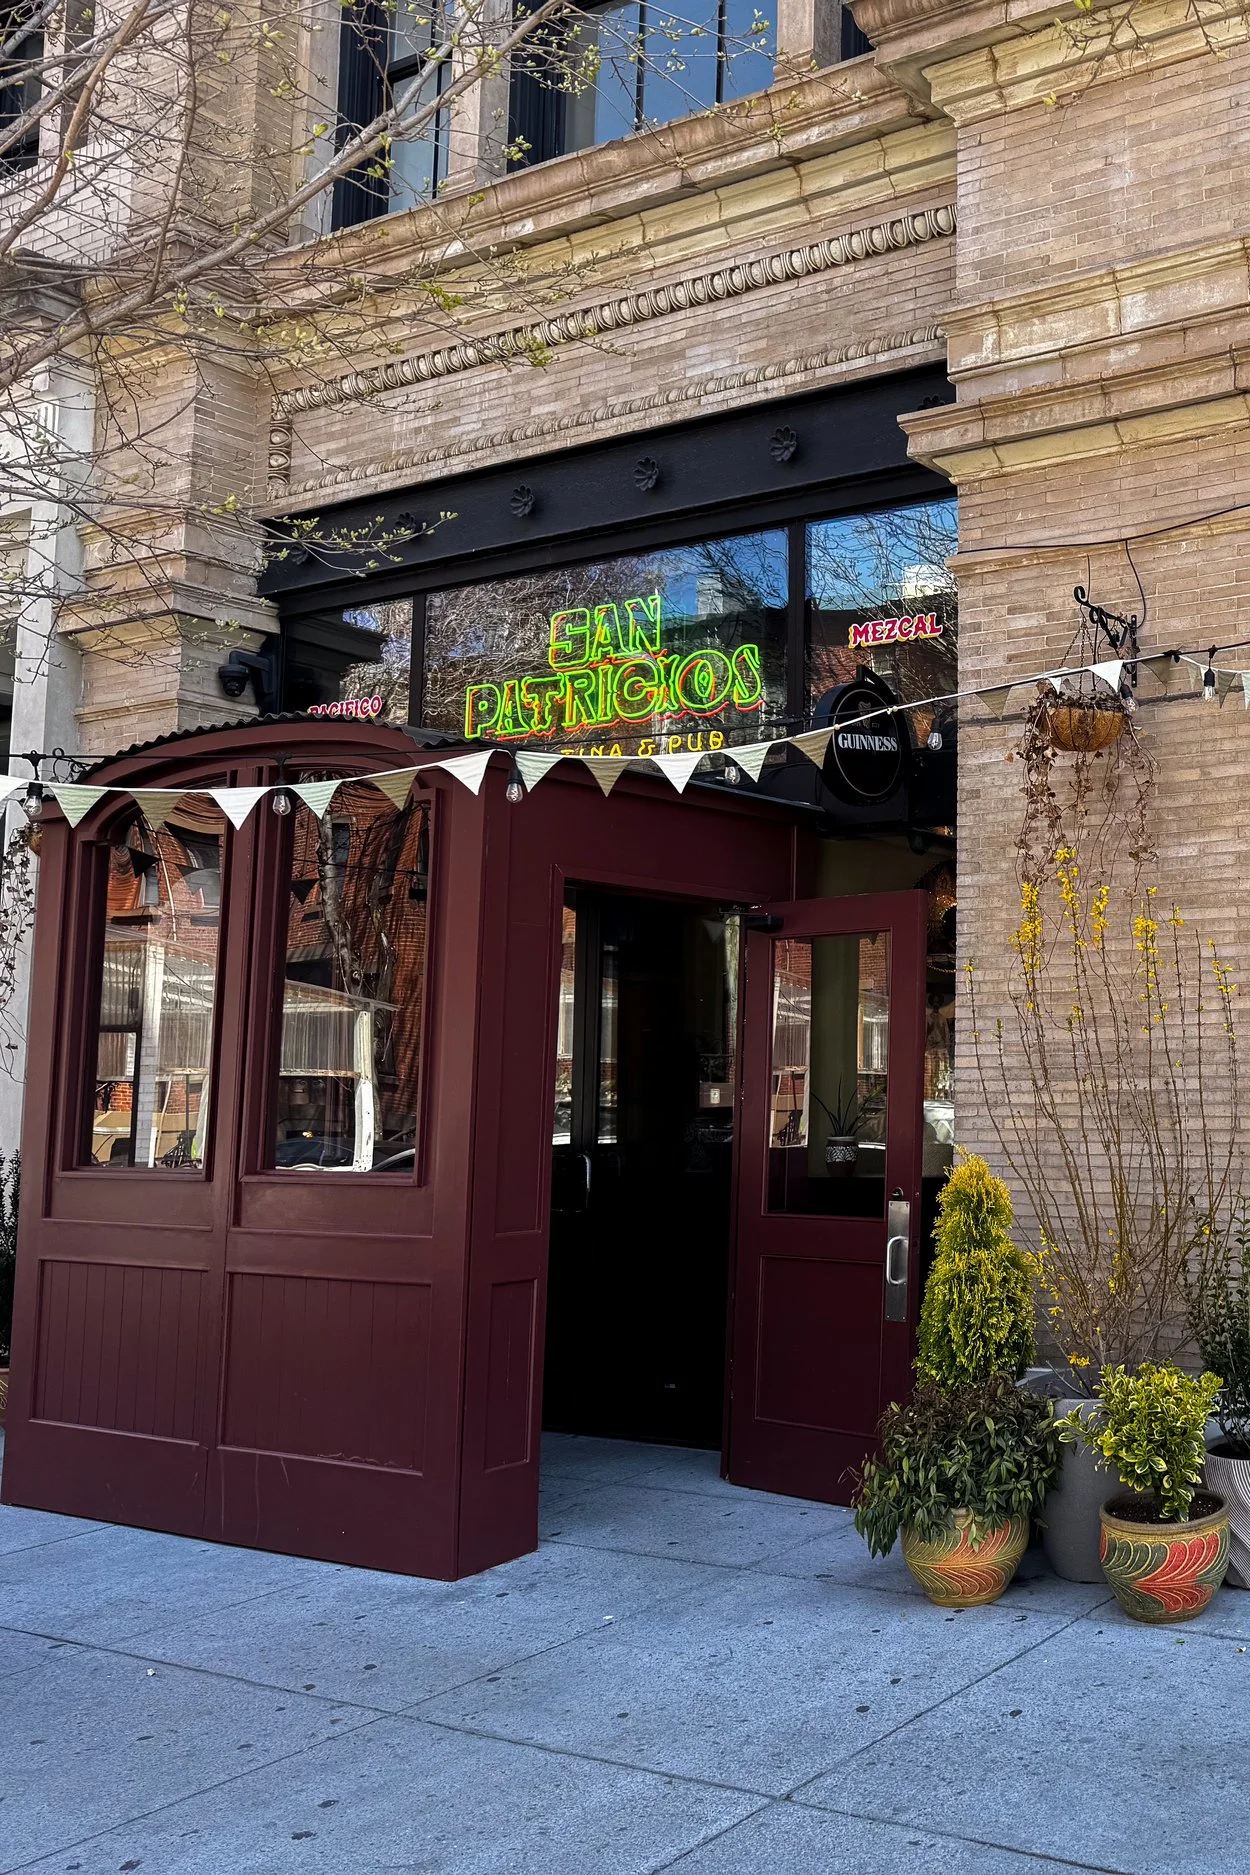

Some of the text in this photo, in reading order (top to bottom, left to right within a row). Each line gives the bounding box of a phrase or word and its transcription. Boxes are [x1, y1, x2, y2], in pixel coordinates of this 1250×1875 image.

[549, 590, 667, 671] SAN
[849, 612, 943, 648] MEZCAL
[465, 644, 768, 741] PATRICIOS
[637, 738, 655, 757] &
[667, 731, 725, 755] PUB
[838, 733, 898, 751] GUINNESS
